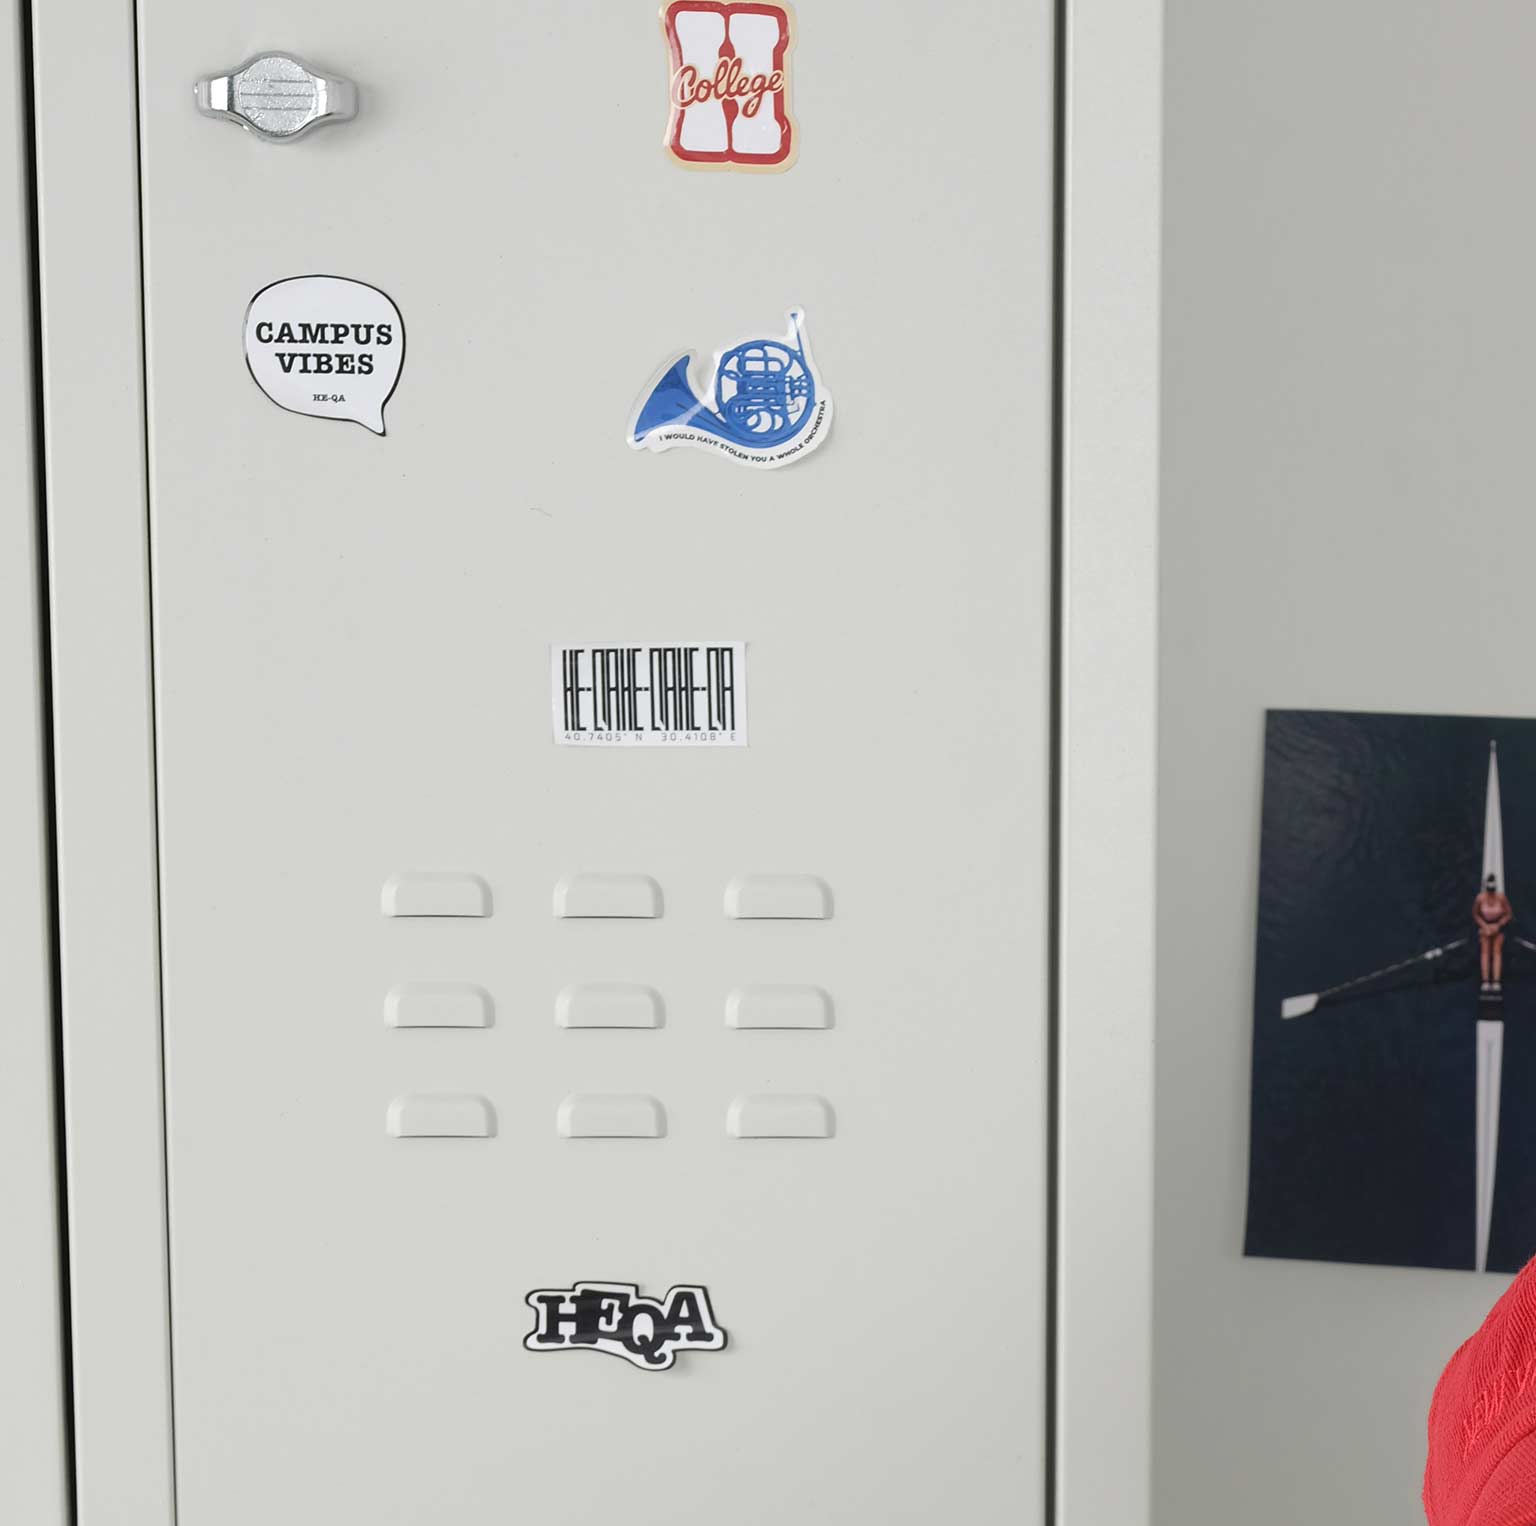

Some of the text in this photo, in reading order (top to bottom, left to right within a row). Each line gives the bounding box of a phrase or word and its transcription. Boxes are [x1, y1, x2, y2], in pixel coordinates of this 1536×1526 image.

[672, 57, 784, 118] College
[256, 321, 392, 345] CAMPUS
[275, 352, 374, 375] VIBES
[313, 394, 345, 403] HE-QA
[665, 433, 695, 441] WOULD
[697, 436, 718, 446] HAVE
[720, 443, 748, 460] STOLEN
[777, 444, 804, 459] WHOLE
[804, 400, 826, 444] ORCHESTRA
[635, 732, 643, 741] N
[730, 732, 736, 741] E
